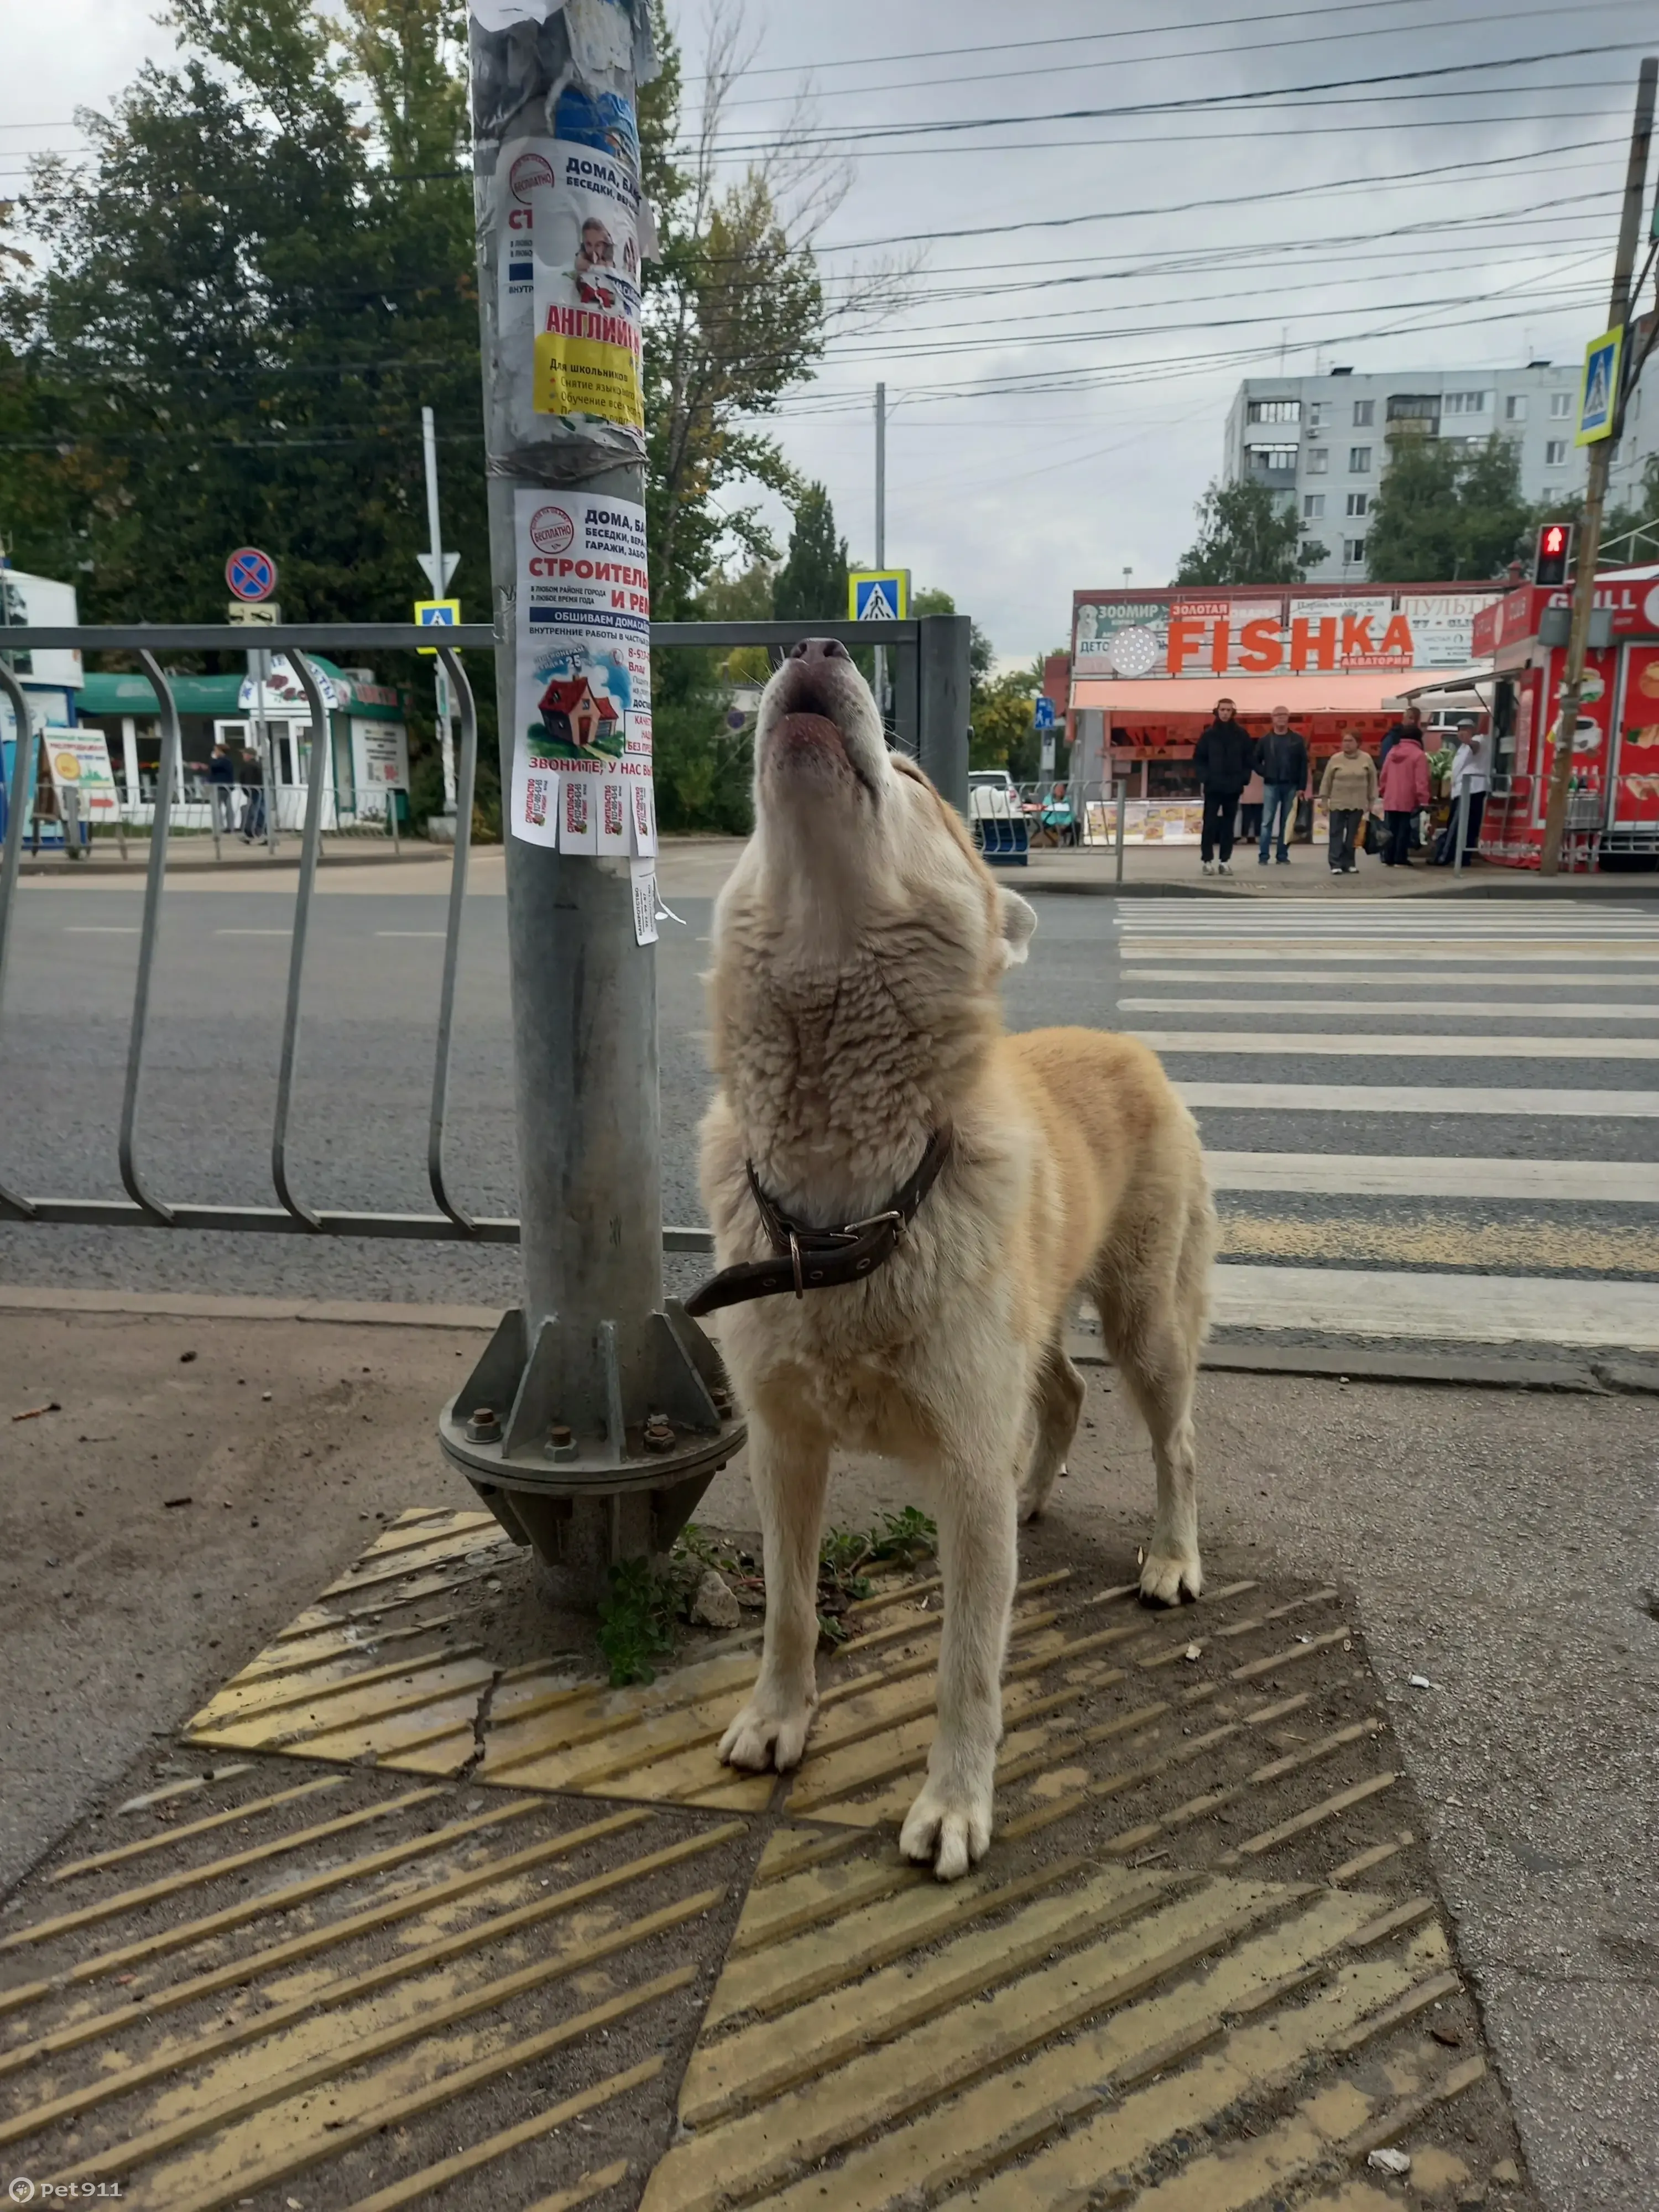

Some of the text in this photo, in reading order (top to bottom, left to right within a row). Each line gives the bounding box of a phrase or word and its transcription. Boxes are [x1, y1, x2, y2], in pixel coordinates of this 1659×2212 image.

[566, 157, 620, 189] ДОМА,
[566, 176, 615, 200] БЕСЕДКИ,
[550, 358, 628, 382] Для школьников
[561, 377, 593, 390] Снятие
[561, 392, 606, 406] Обучение
[585, 509, 633, 531] ДОМА,
[534, 525, 571, 542] БЕСПЛАТНО
[586, 527, 629, 543] БЕСЕДКИ,
[586, 540, 627, 556] ГАРАЖИ,
[560, 586, 583, 595] РАЙОНЕ
[611, 589, 625, 609] И
[1099, 605, 1158, 619] ЗООМИР
[1173, 604, 1228, 615] ЗОЛОТАЯ
[555, 611, 613, 625] ОБШИВАЕМ
[615, 618, 637, 629] ДОМА
[529, 627, 583, 637] ВНУТРЕННИЕ
[586, 629, 617, 639] РАБОТЫ
[1167, 615, 1414, 673] FISHKA
[1342, 656, 1410, 666] АКВАТОРИИ
[628, 742, 640, 751] БЕЗ
[529, 757, 603, 775] ЗВОНИТЕ,
[608, 762, 617, 773] У
[621, 763, 641, 775] НАС
[525, 779, 535, 823] СТРОИТЕЛЬСТВО
